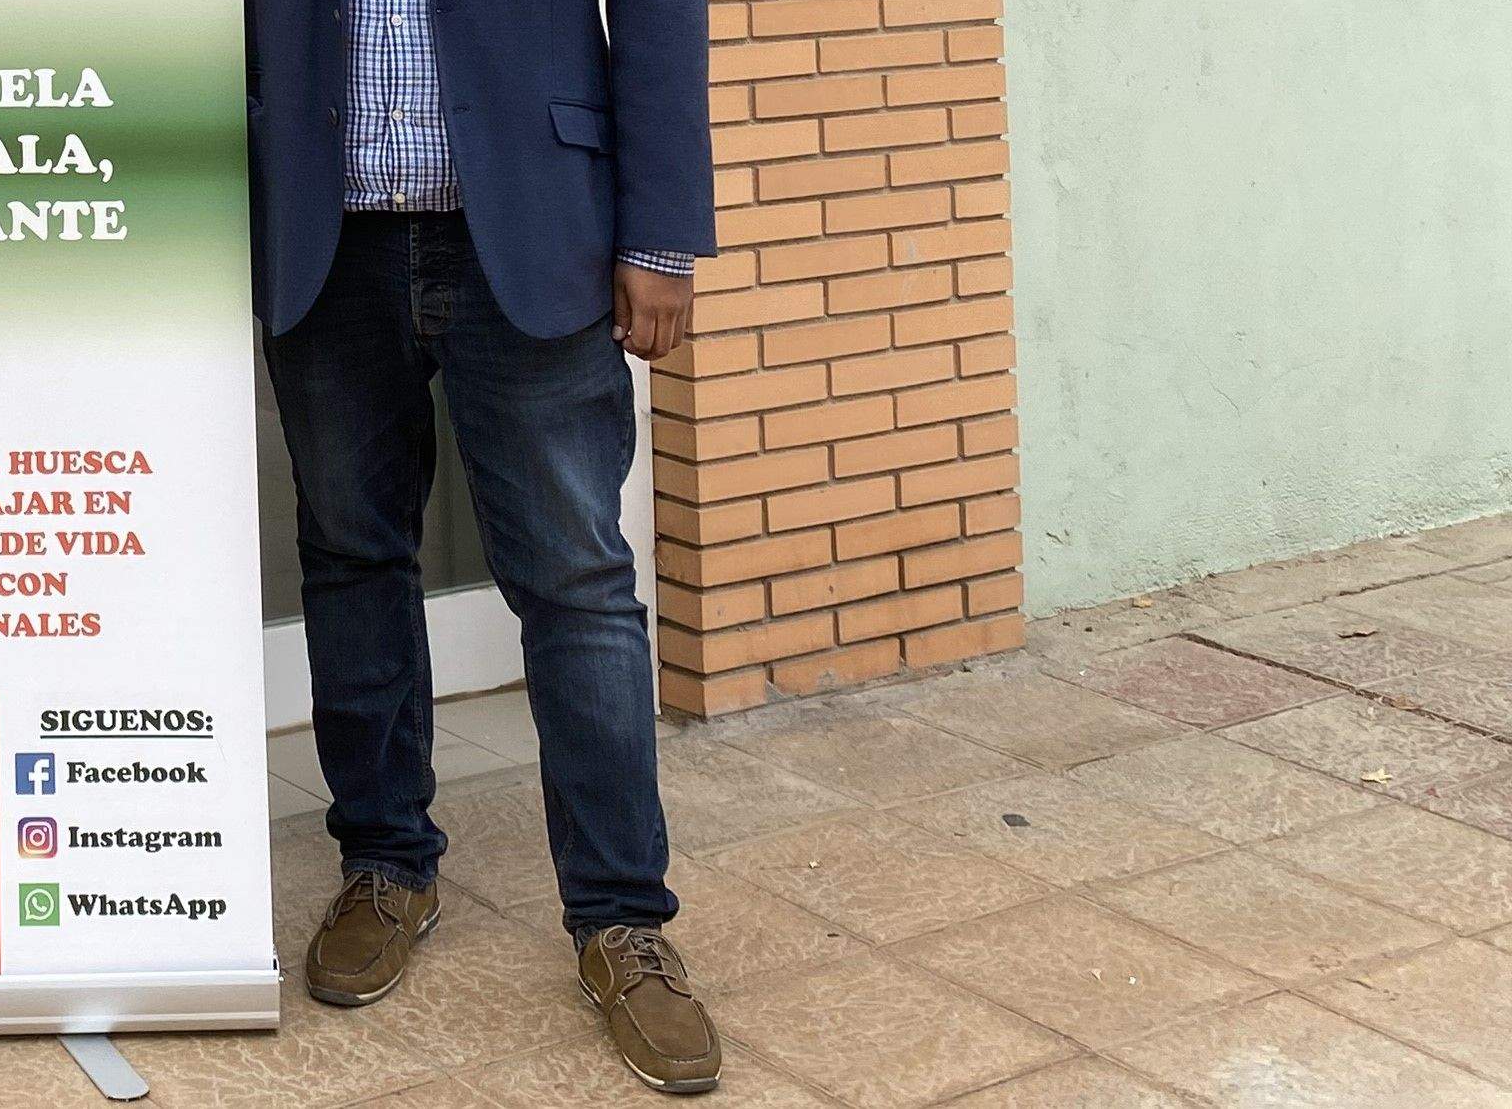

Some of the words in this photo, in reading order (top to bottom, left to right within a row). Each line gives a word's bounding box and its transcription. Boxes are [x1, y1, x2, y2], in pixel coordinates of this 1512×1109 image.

[8, 450, 154, 476] HUESCA
[83, 490, 132, 515] EN
[54, 530, 146, 556] VIDA
[40, 709, 213, 732] SIGUENOS:
[66, 761, 208, 784] Facebook
[68, 826, 223, 853] Instagram
[67, 893, 227, 921] WhatsApp
